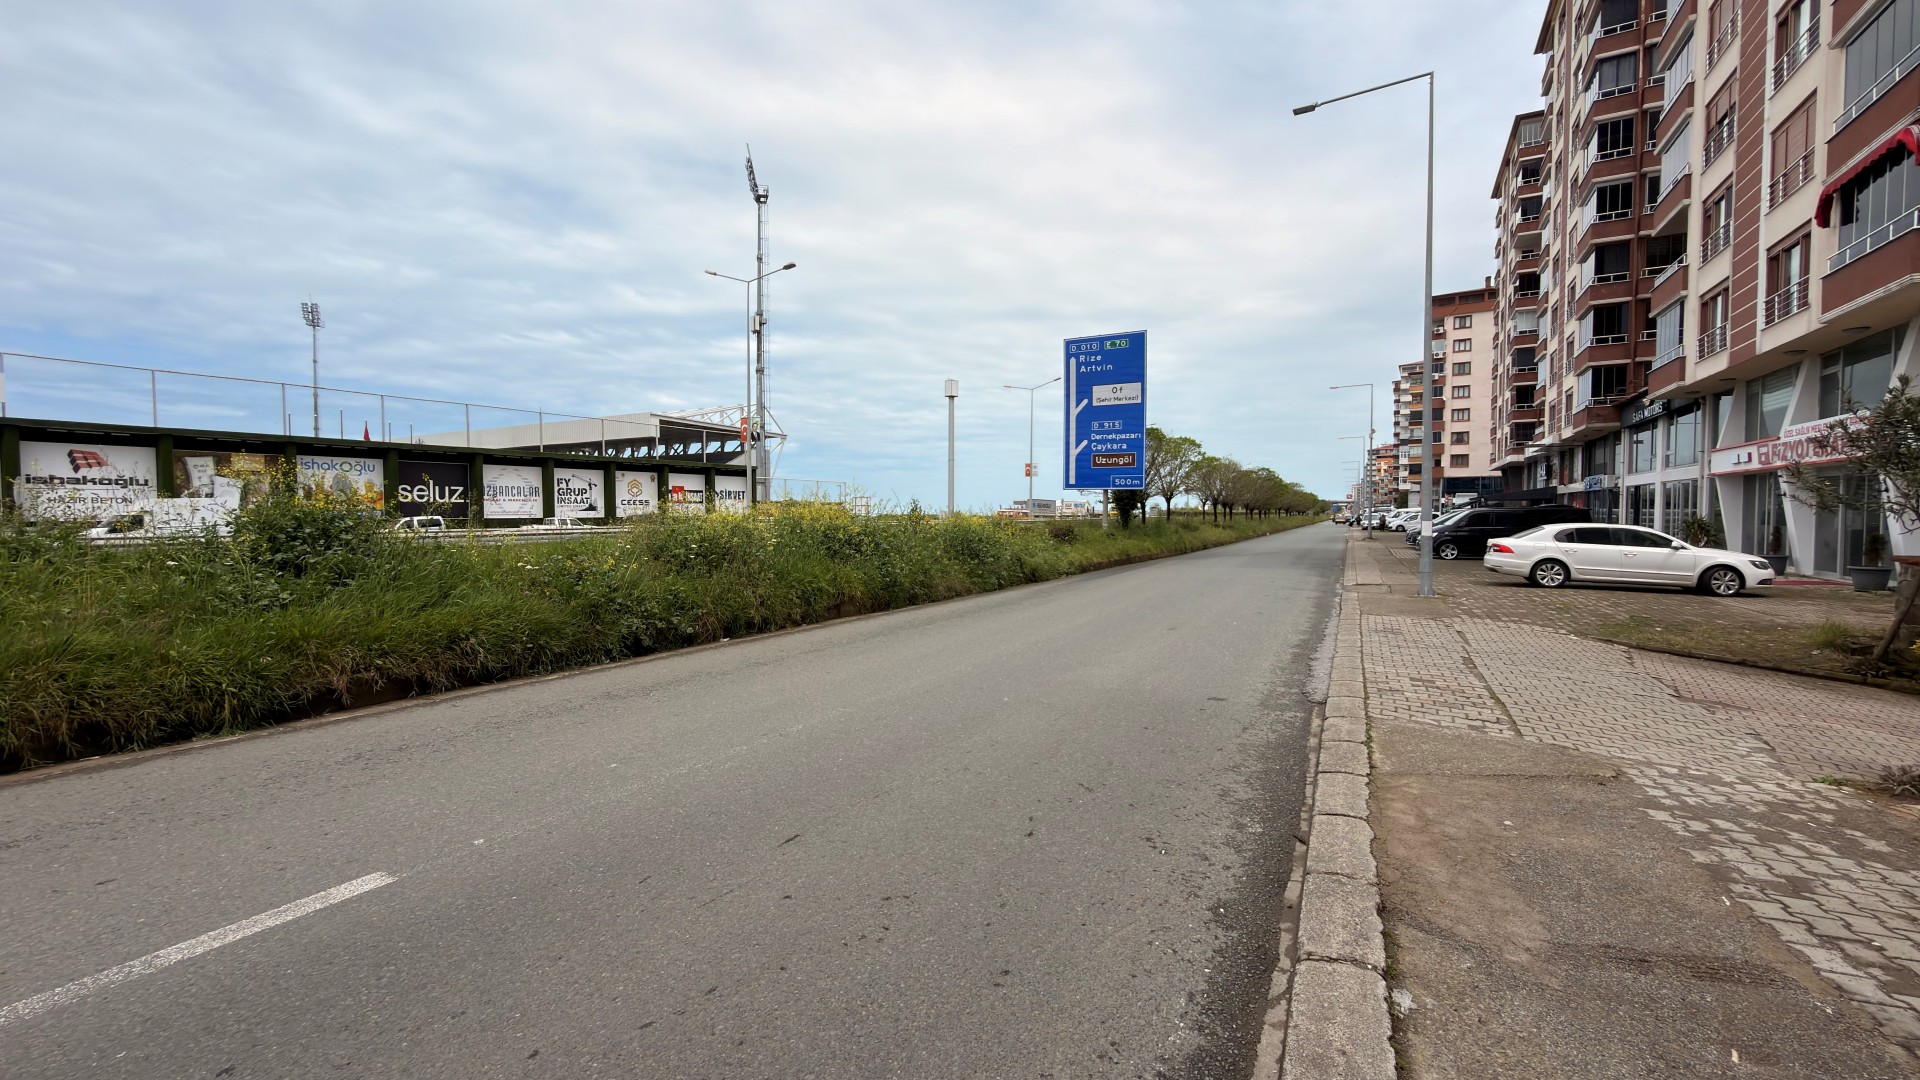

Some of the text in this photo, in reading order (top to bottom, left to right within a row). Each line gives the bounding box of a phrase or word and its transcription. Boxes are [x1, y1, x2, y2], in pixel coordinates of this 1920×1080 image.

[1080, 343, 1097, 351] 010
[1079, 354, 1102, 362] Rize
[1080, 364, 1113, 373] Artvin
[1111, 386, 1123, 394] Of
[1103, 421, 1120, 429] 915
[1091, 442, 1127, 451] Çaykara
[1095, 455, 1132, 465] Uzungöl
[25, 473, 149, 489] ishakoğlu
[556, 477, 571, 487] FY
[557, 487, 588, 497] GRUP
[91, 496, 133, 504] BETON
